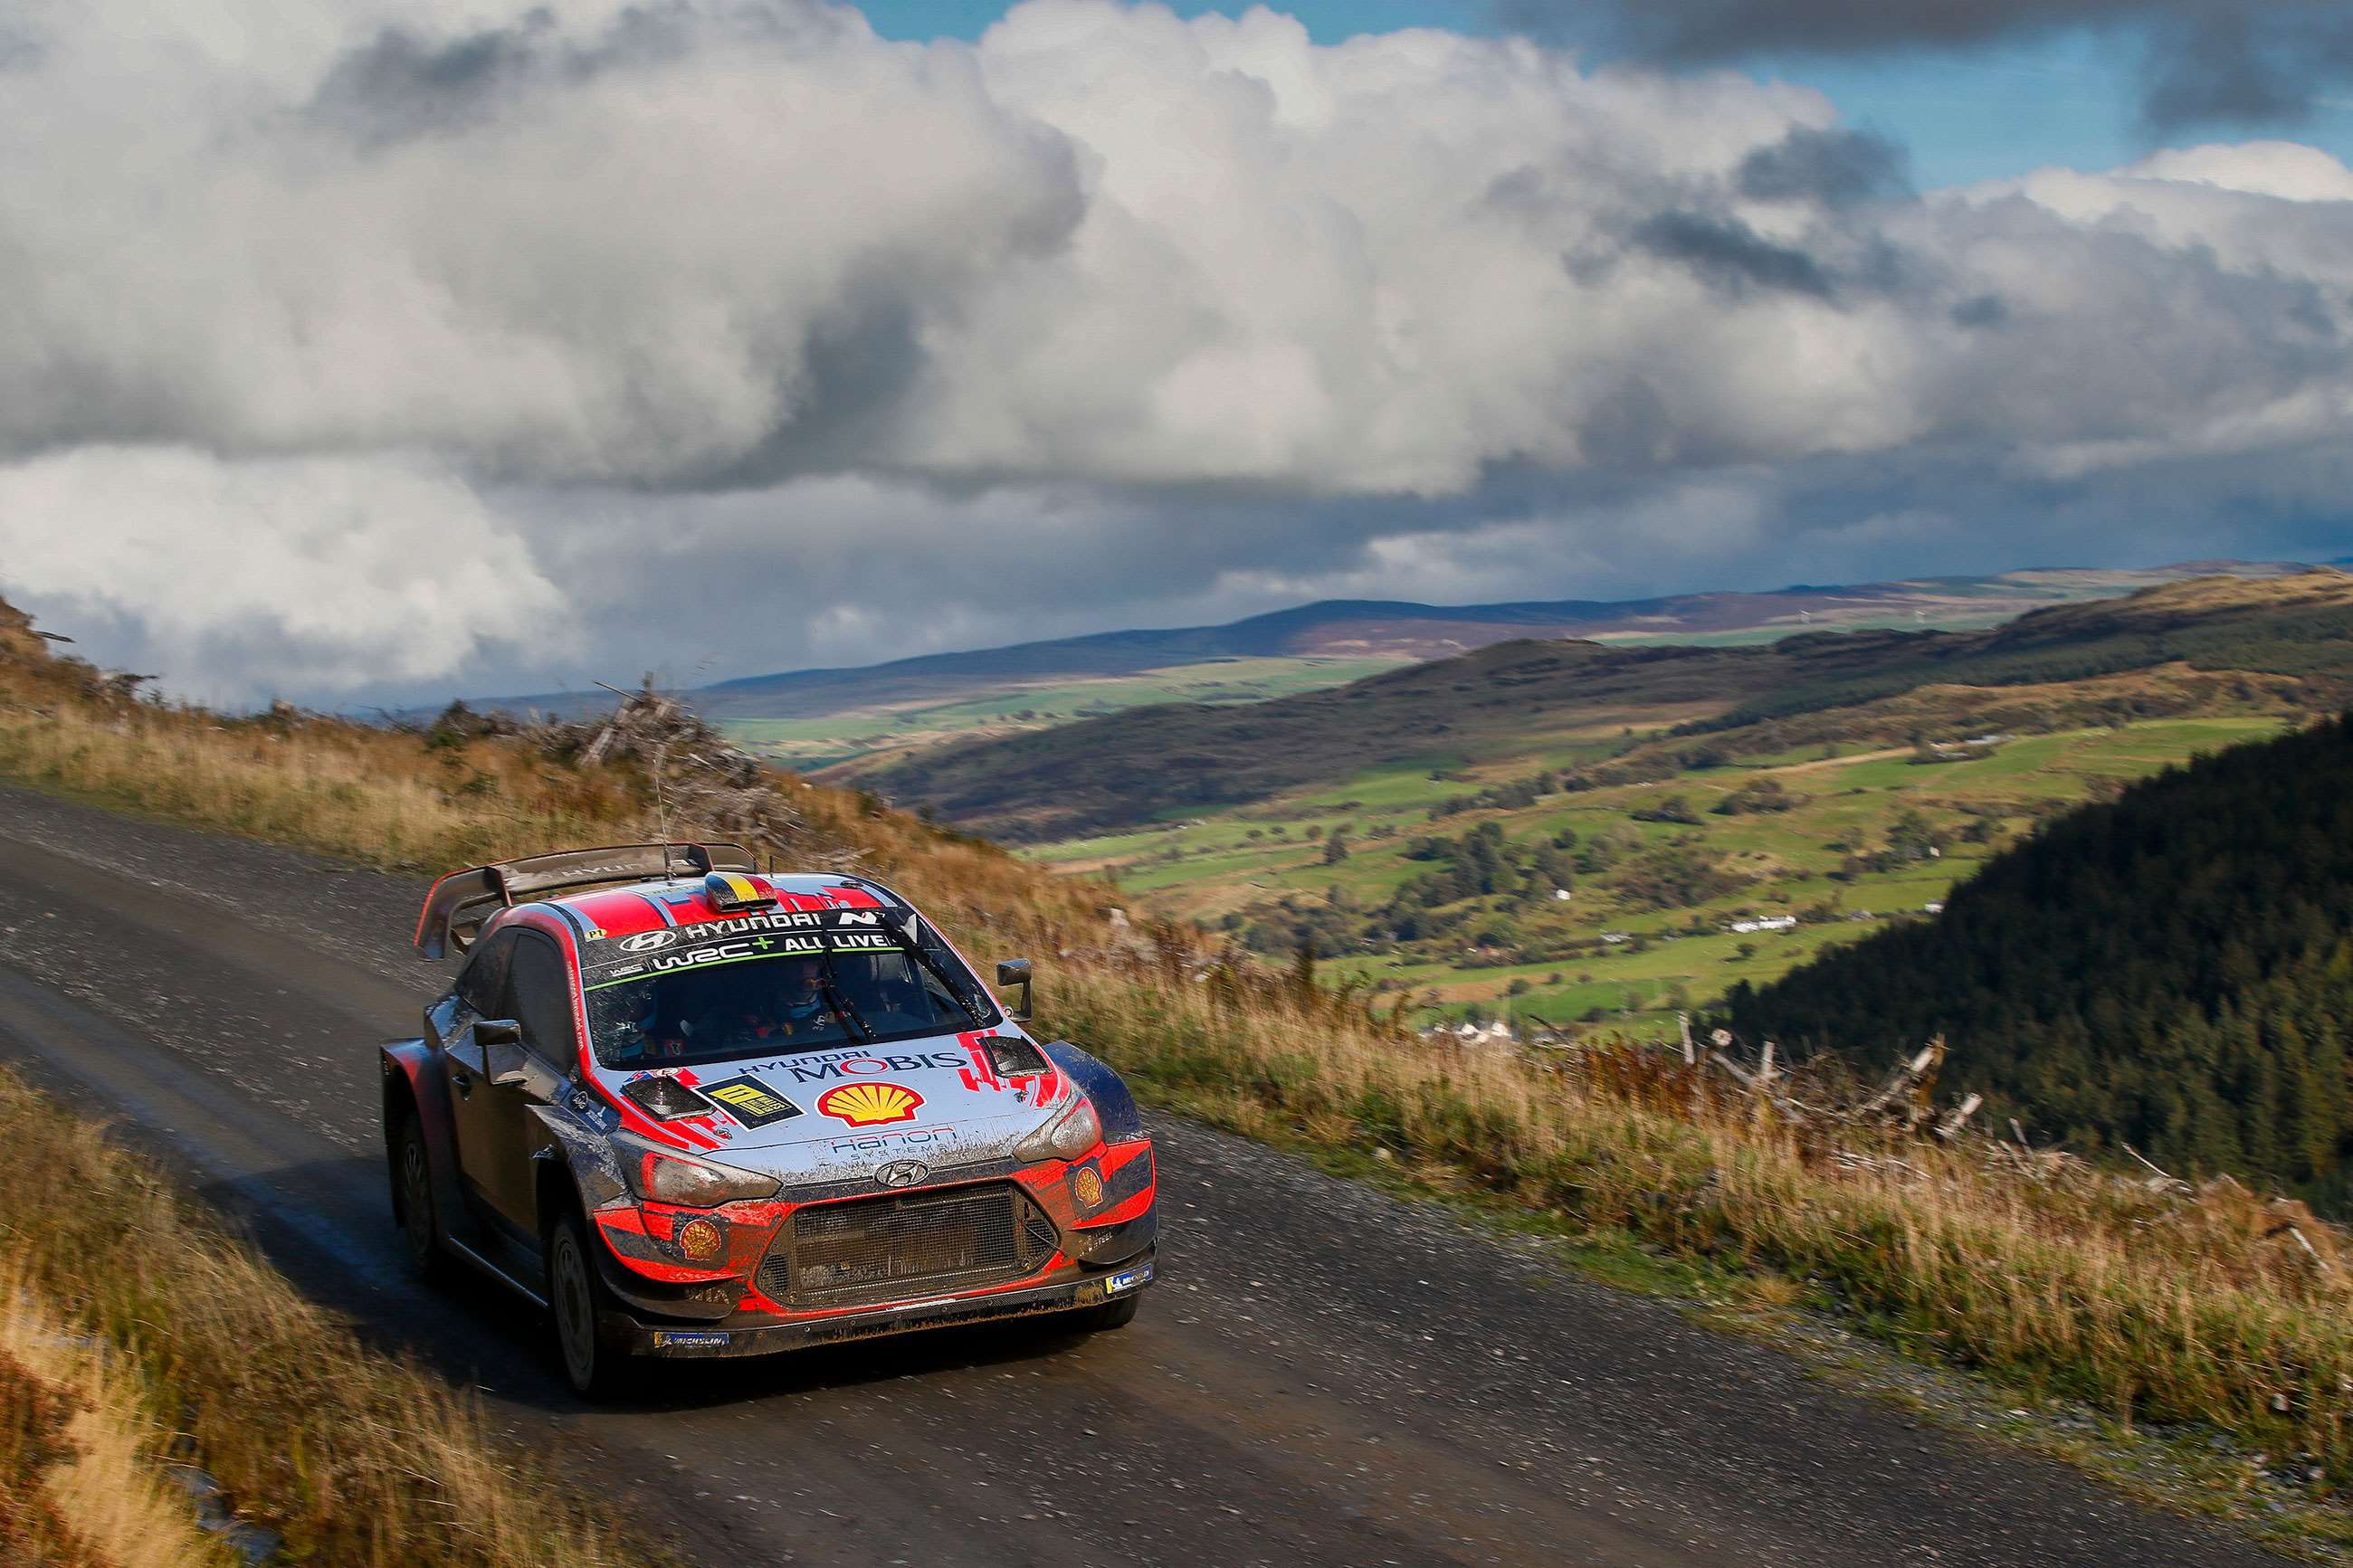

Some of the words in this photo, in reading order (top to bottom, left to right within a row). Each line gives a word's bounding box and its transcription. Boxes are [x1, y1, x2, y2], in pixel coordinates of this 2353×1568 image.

[589, 928, 604, 938] P1
[685, 913, 822, 939] HYUNDAI
[785, 936, 826, 951] ALL
[833, 935, 889, 948] LIVE
[738, 1050, 872, 1075] HYUNDAI
[788, 1052, 967, 1084] MOBIS
[722, 1088, 751, 1099] 11
[850, 1143, 950, 1161] SYSTEMS
